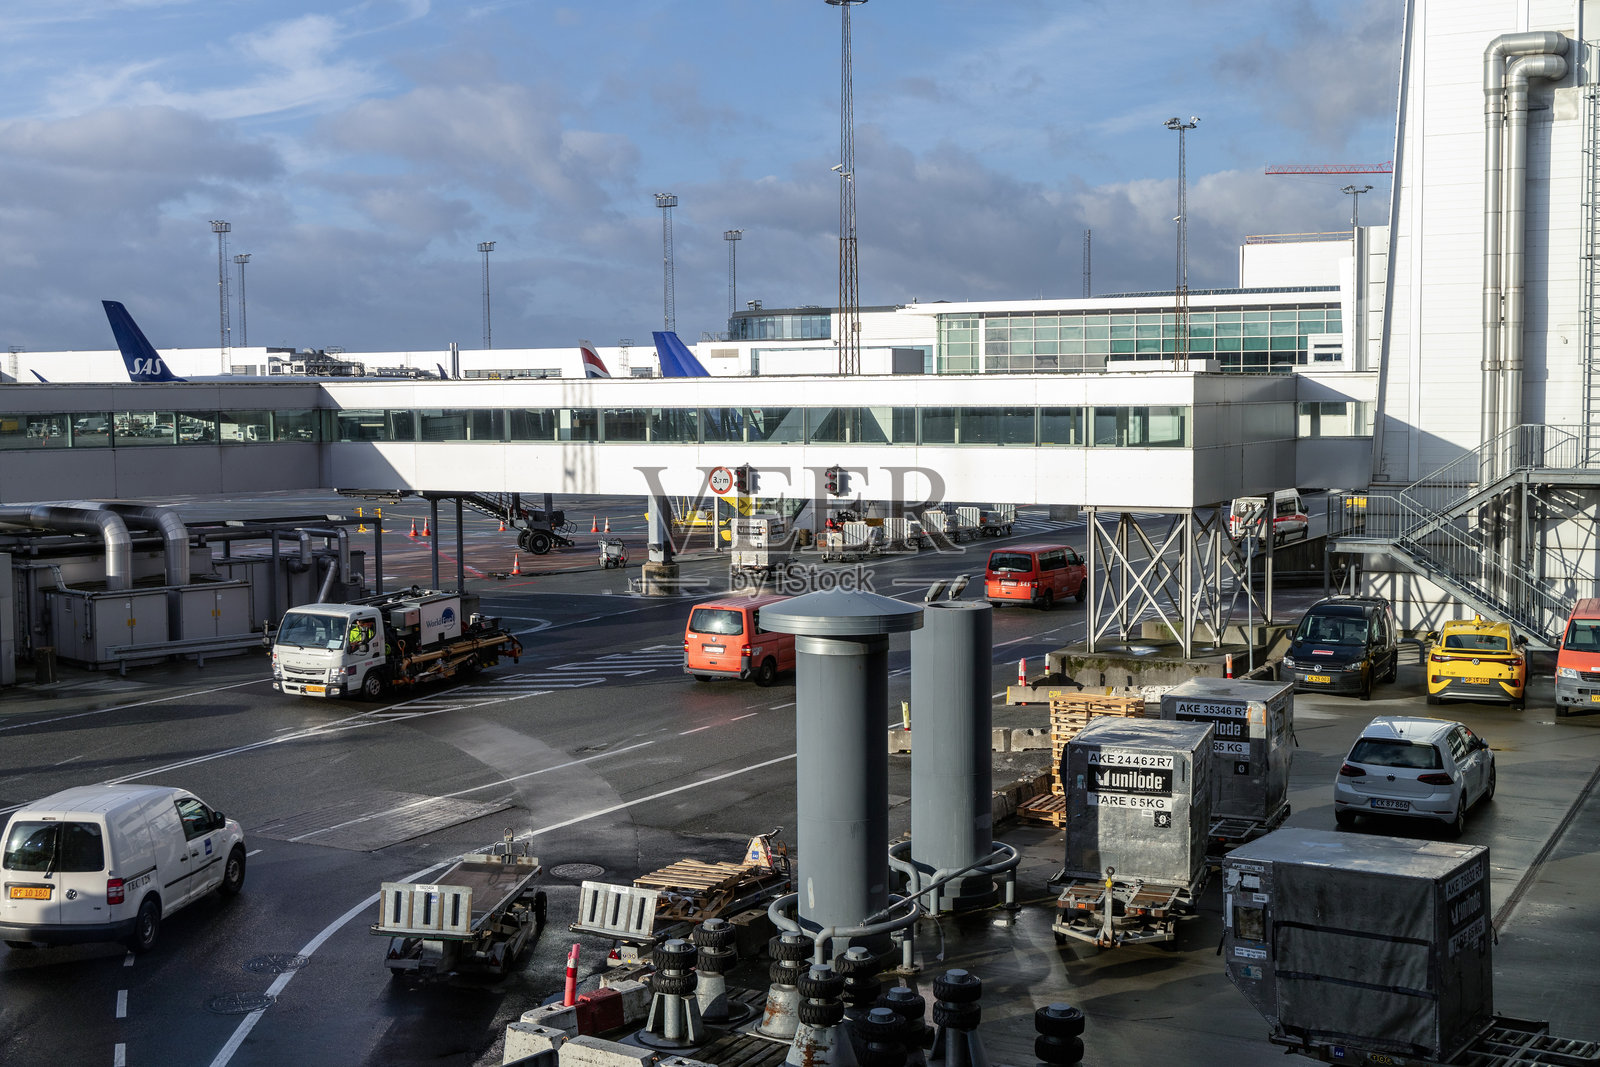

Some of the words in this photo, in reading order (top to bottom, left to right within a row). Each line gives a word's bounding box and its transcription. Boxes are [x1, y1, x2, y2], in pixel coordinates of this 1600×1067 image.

[130, 358, 163, 375] SAS
[1179, 704, 1200, 713] AKE
[1204, 705, 1232, 716] 35346
[1235, 707, 1247, 717] R7
[1213, 742, 1224, 750] 65
[1227, 744, 1243, 752] KG
[1089, 753, 1115, 763] AKE
[1111, 771, 1162, 789] unilode
[1095, 795, 1127, 805] TARE
[127, 880, 140, 892] TEC
[1447, 879, 1459, 897] AKE
